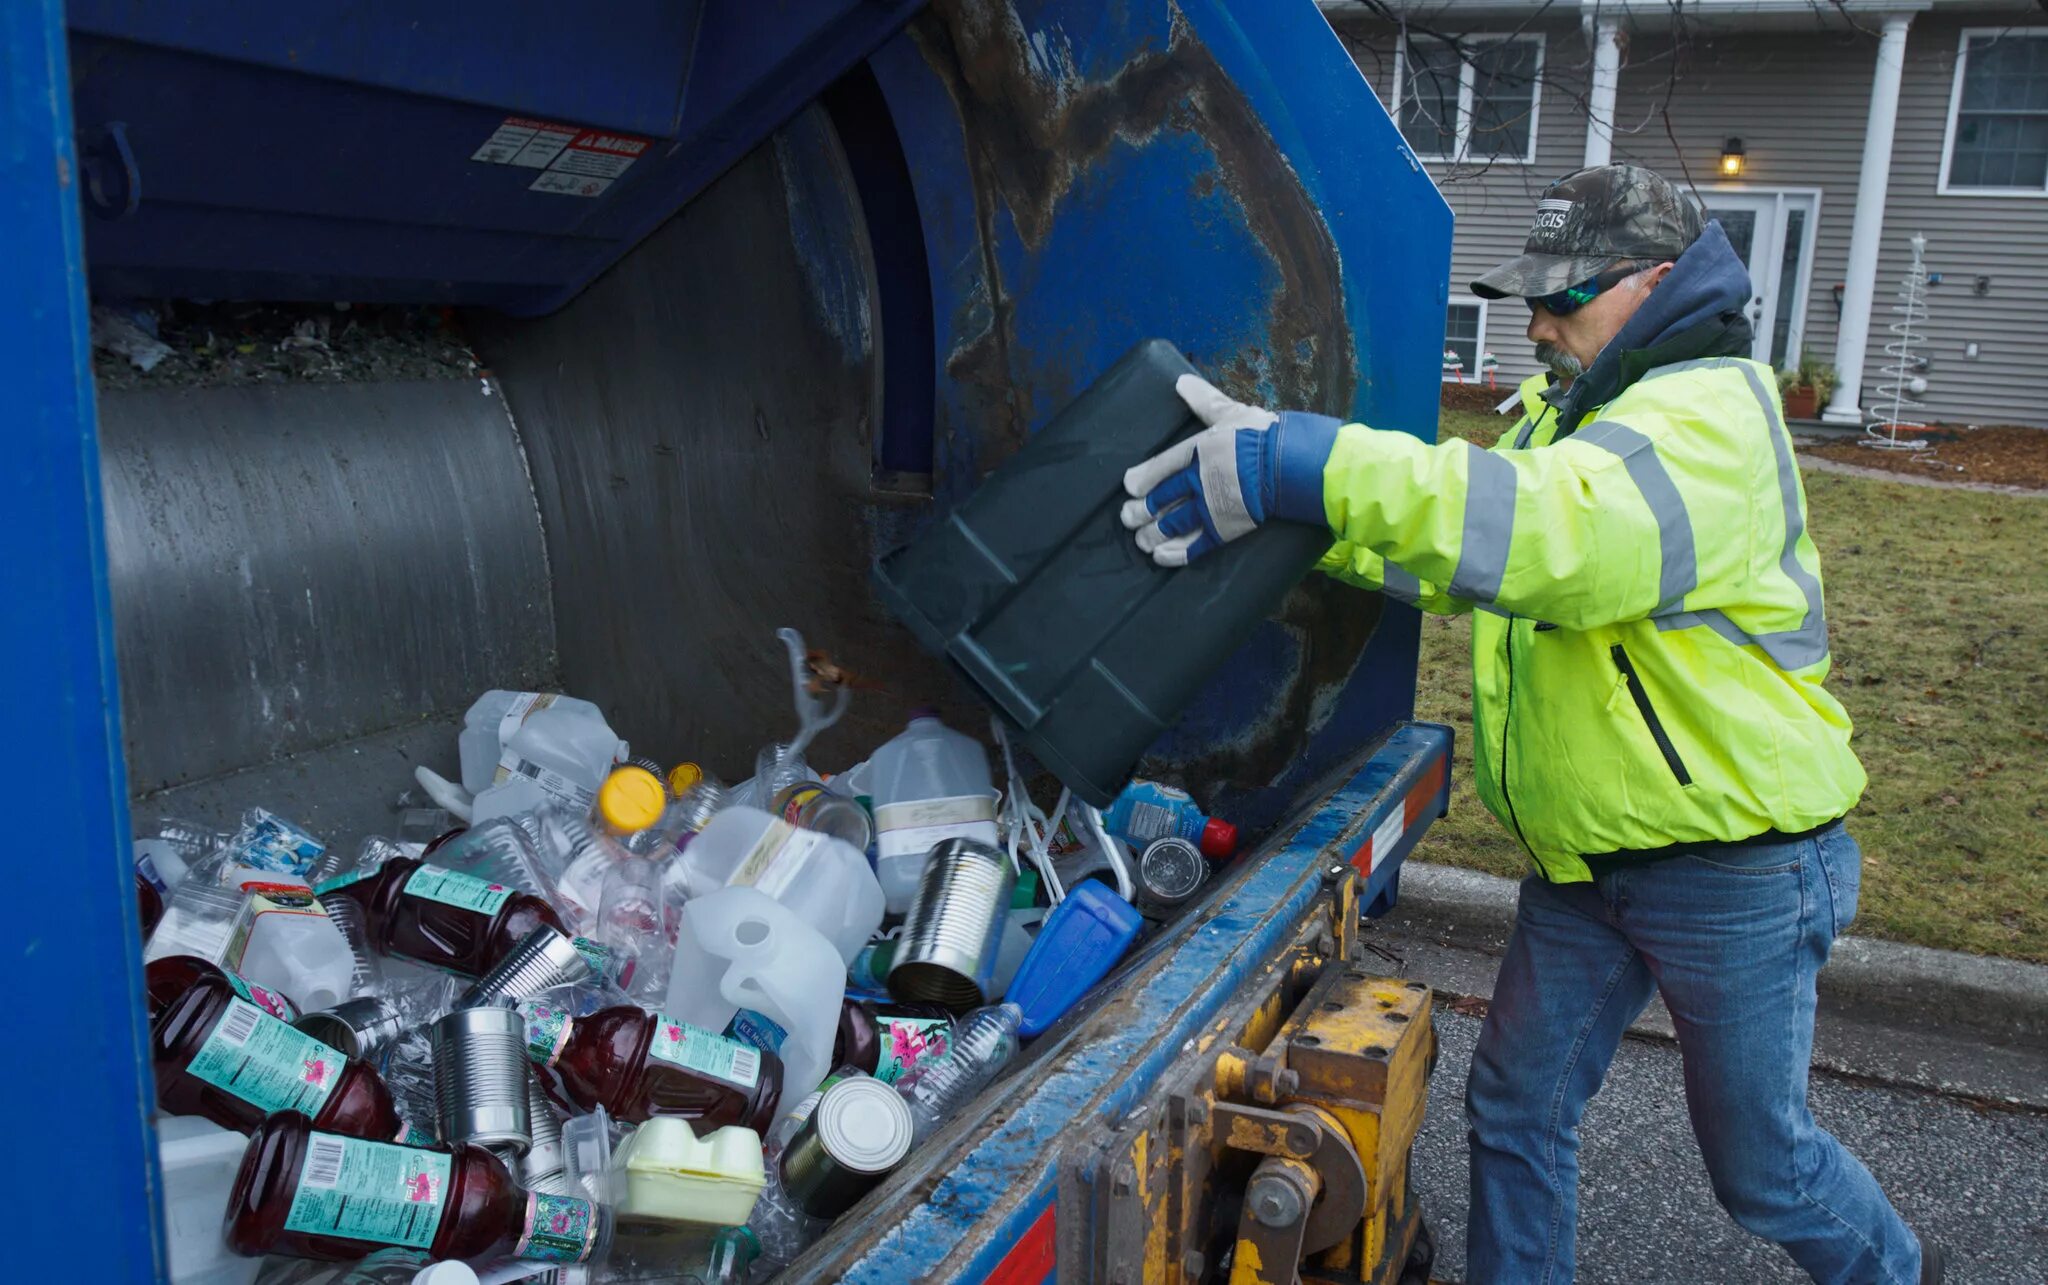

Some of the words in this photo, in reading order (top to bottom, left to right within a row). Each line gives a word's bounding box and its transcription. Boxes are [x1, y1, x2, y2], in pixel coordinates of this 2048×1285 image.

[1532, 213, 1566, 228] EGIS
[738, 1022, 754, 1036] ICE
[888, 1056, 903, 1084] Gre
